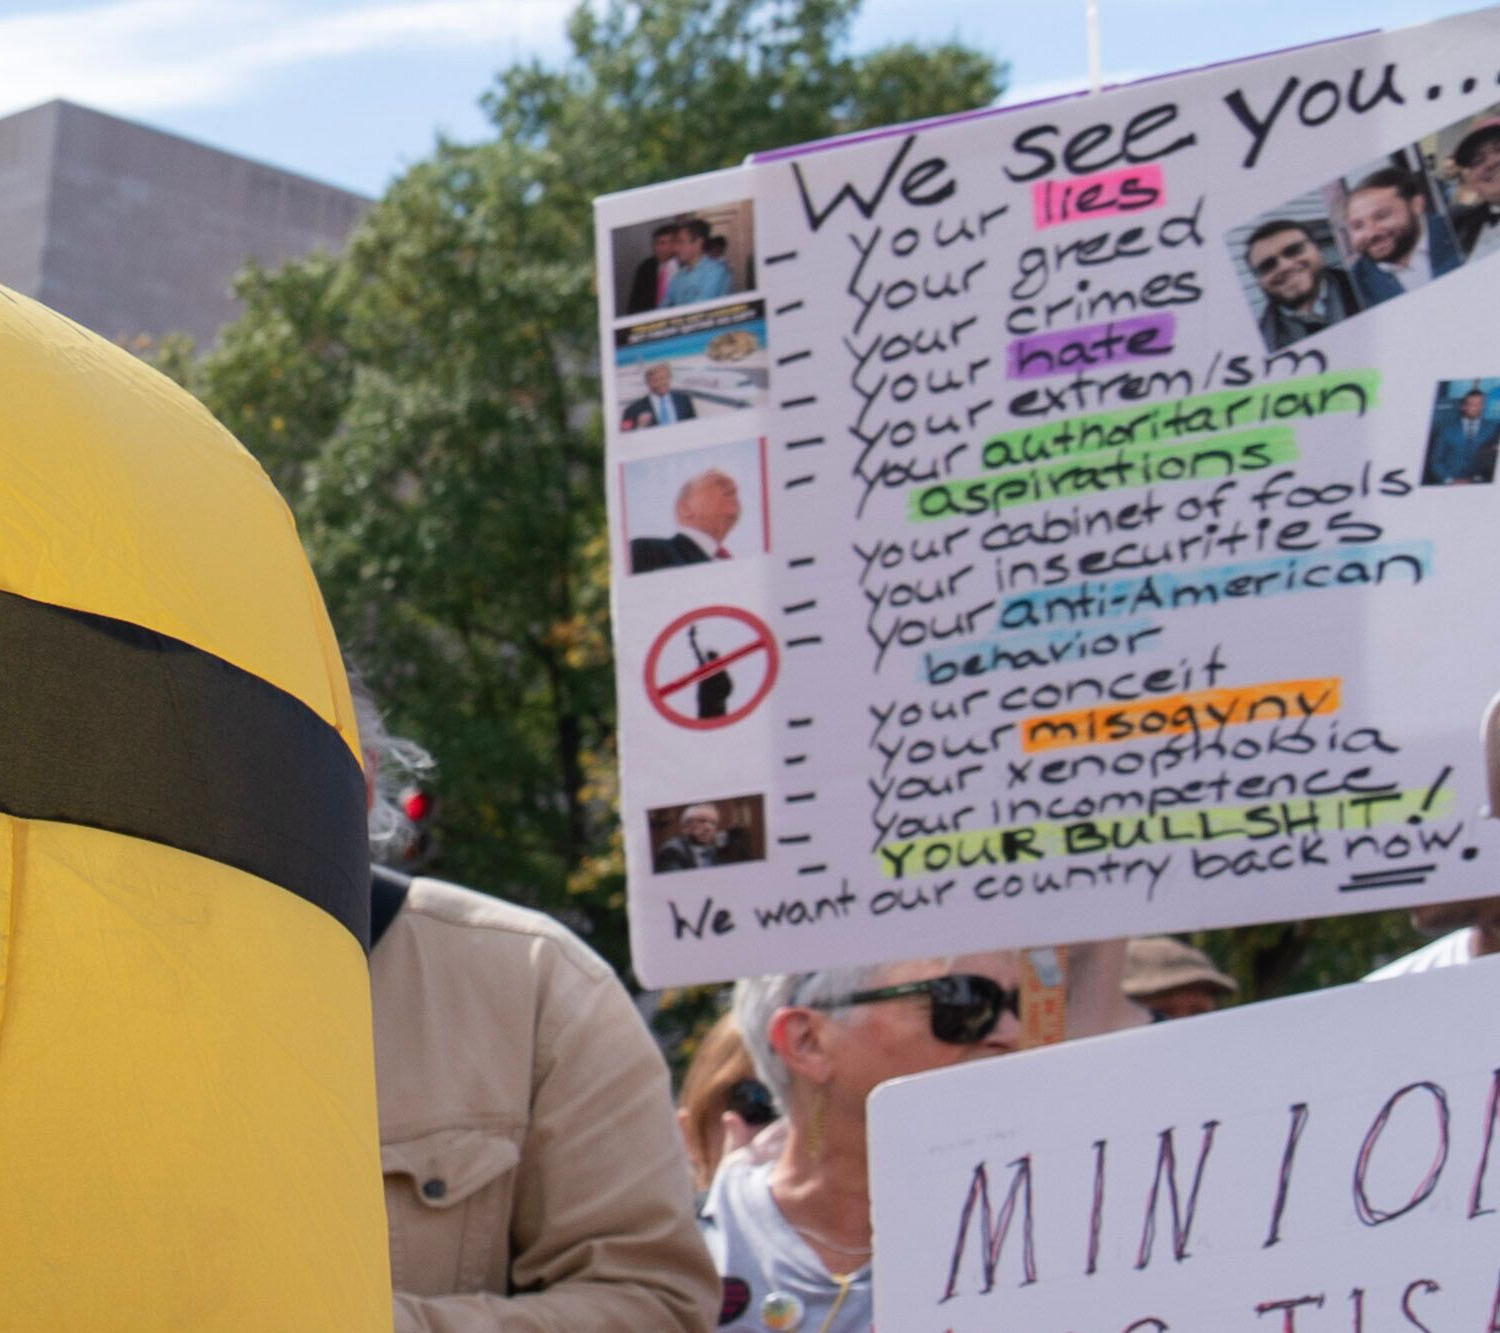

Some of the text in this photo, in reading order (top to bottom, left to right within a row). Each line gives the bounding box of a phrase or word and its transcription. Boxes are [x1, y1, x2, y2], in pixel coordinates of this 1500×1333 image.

[792, 135, 957, 232] We
[1004, 103, 1196, 182] see
[849, 179, 1160, 295] your lies
[852, 261, 987, 336] your
[1010, 196, 1205, 300] greed
[844, 272, 1202, 396] your crimes
[851, 322, 1175, 432] your hate
[849, 399, 994, 476] your
[854, 380, 1368, 519] your authoritarian
[917, 439, 1273, 518] aspirations
[854, 462, 1415, 586] your cabinet of fools
[865, 509, 1383, 626] your insecurities
[866, 553, 1423, 673] your anti-American
[927, 624, 1164, 686] behavior
[869, 644, 1228, 739] your conceit
[874, 689, 1332, 777] your misogyny
[868, 722, 1401, 812] your xenophobia
[871, 766, 1403, 858] your incompetence
[880, 765, 1455, 879] YOUR BULLSHIT!
[668, 898, 736, 941] We
[754, 879, 857, 931] want
[871, 881, 956, 916] our
[974, 852, 1172, 902] country
[1192, 832, 1328, 880] back
